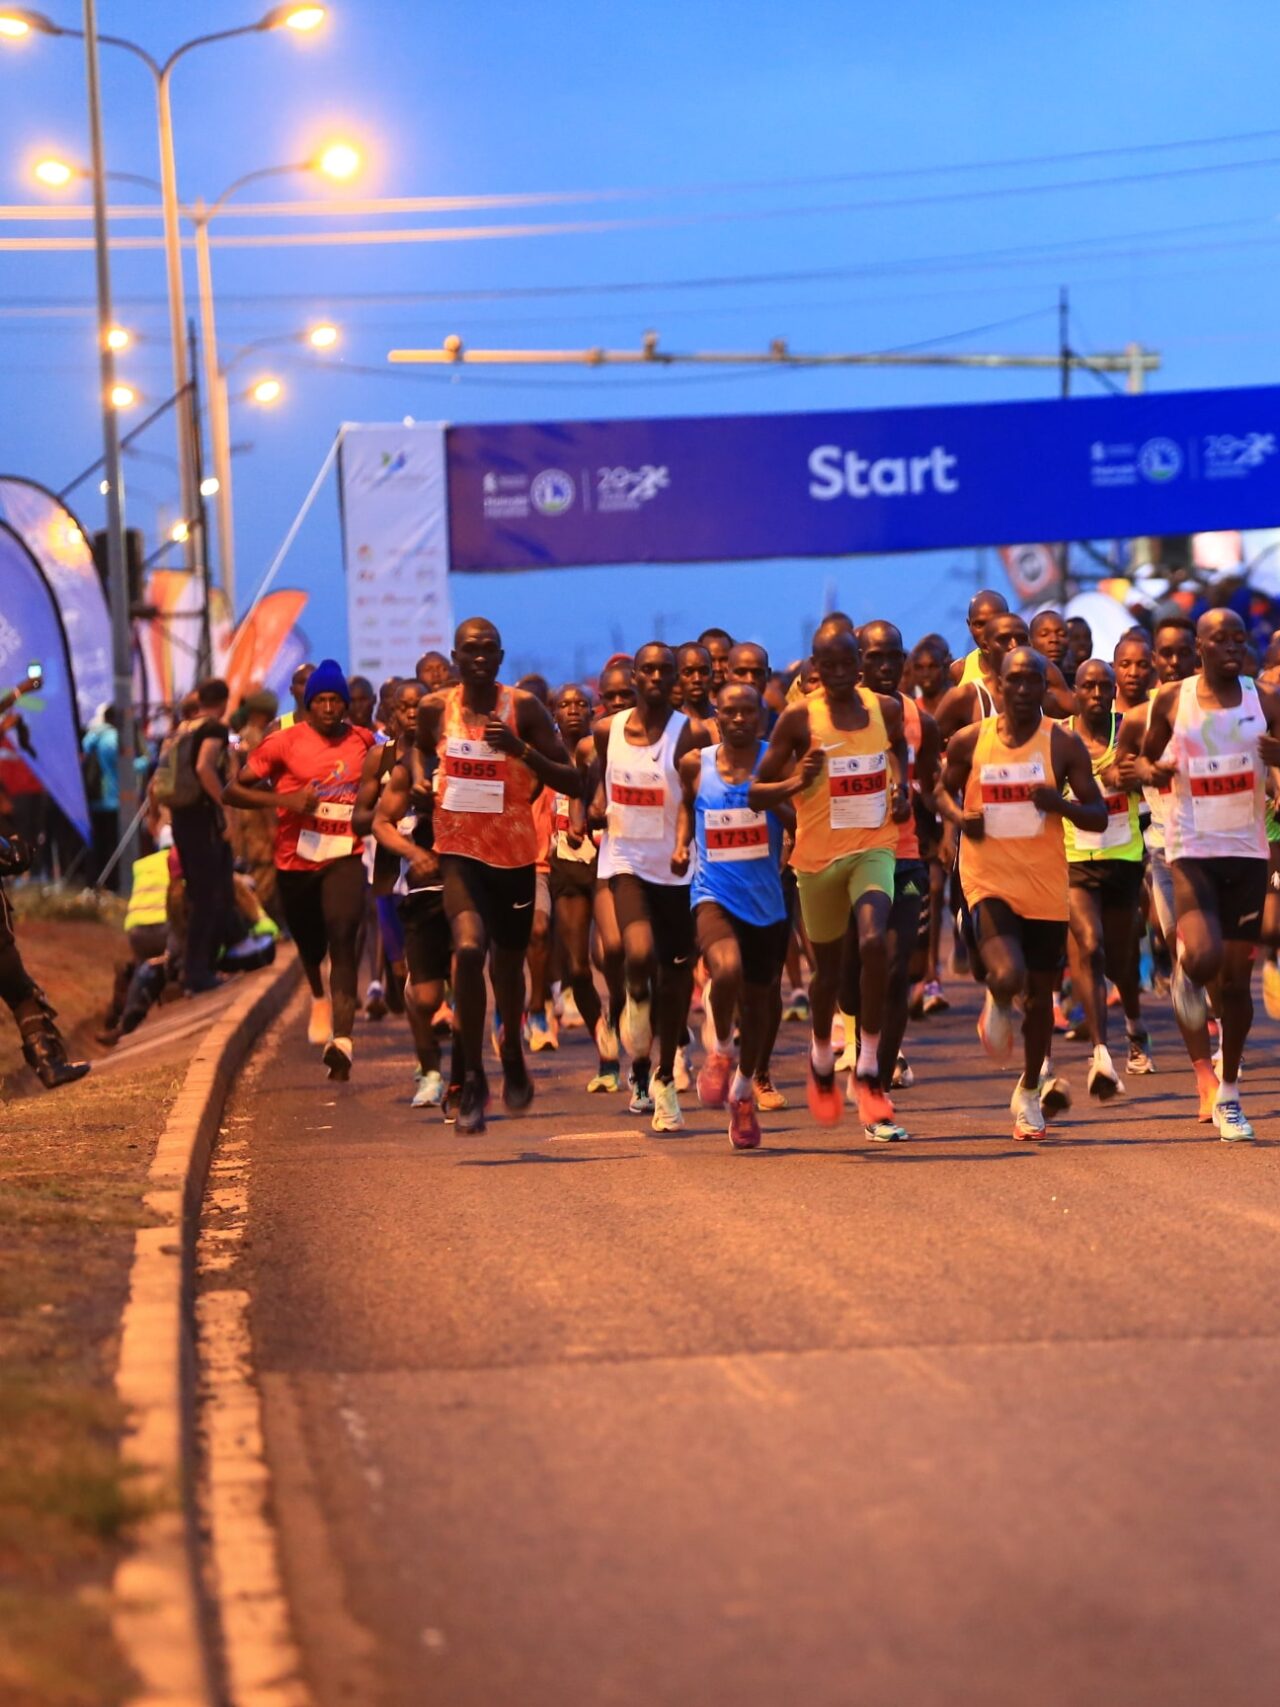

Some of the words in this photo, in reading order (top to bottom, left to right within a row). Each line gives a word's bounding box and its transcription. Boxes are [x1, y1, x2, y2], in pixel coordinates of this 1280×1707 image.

[808, 444, 958, 500] Start
[452, 760, 497, 778] 1955
[839, 774, 883, 793] 1630
[991, 784, 1032, 801] 183
[713, 828, 761, 846] 1733
